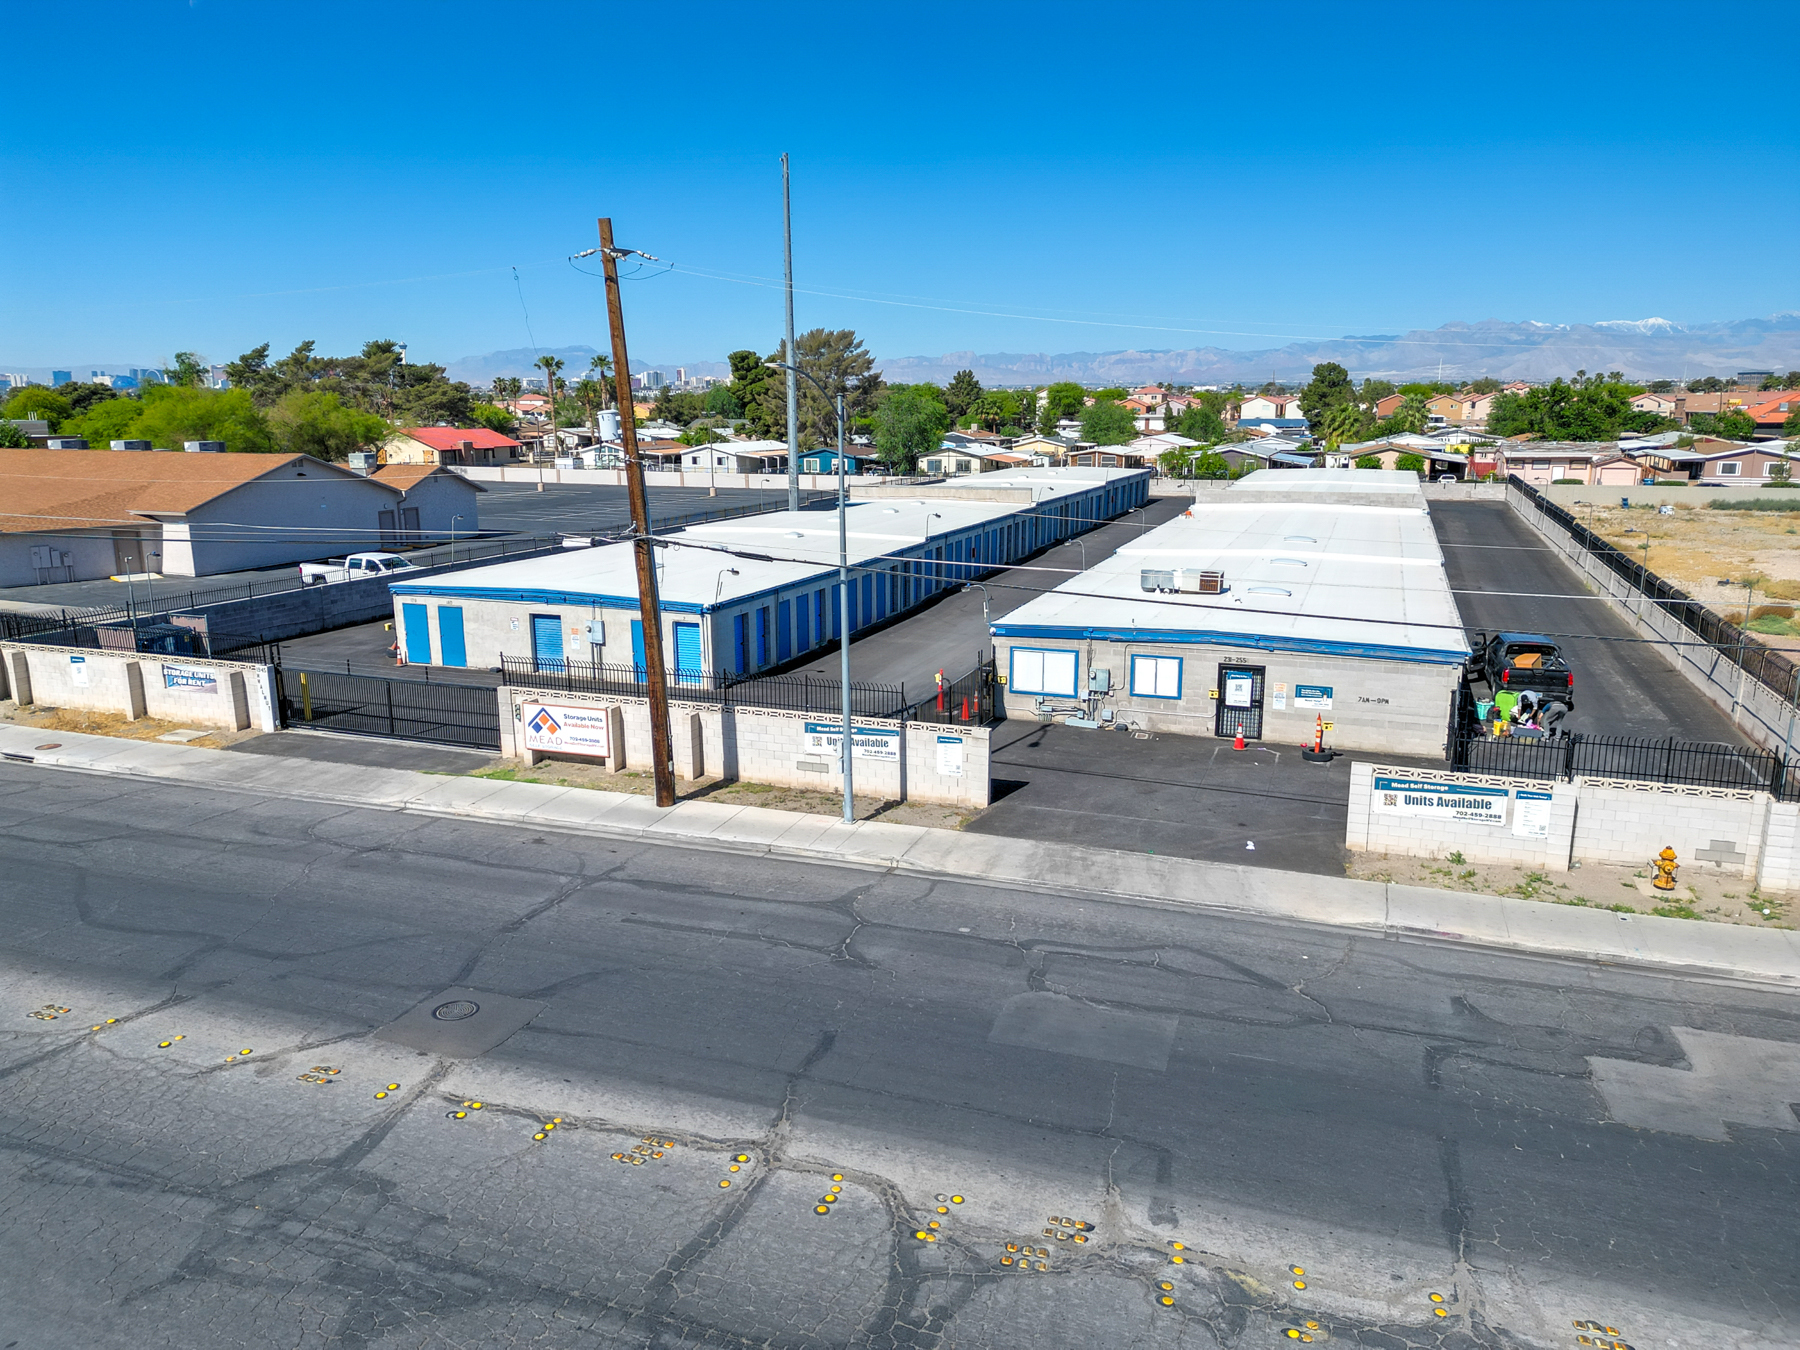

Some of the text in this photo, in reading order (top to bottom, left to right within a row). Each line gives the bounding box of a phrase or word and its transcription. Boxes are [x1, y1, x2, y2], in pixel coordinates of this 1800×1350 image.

[163, 668, 215, 680] STORAGE UNITS
[173, 677, 206, 687] FOR RENT
[563, 713, 603, 723] Storage Units
[563, 721, 590, 729] Available
[529, 734, 563, 746] MEAD
[850, 737, 889, 748] Available
[1423, 784, 1449, 792] Storage
[1404, 794, 1492, 810] Units Available
[1455, 810, 1502, 820] 702-459-2888
